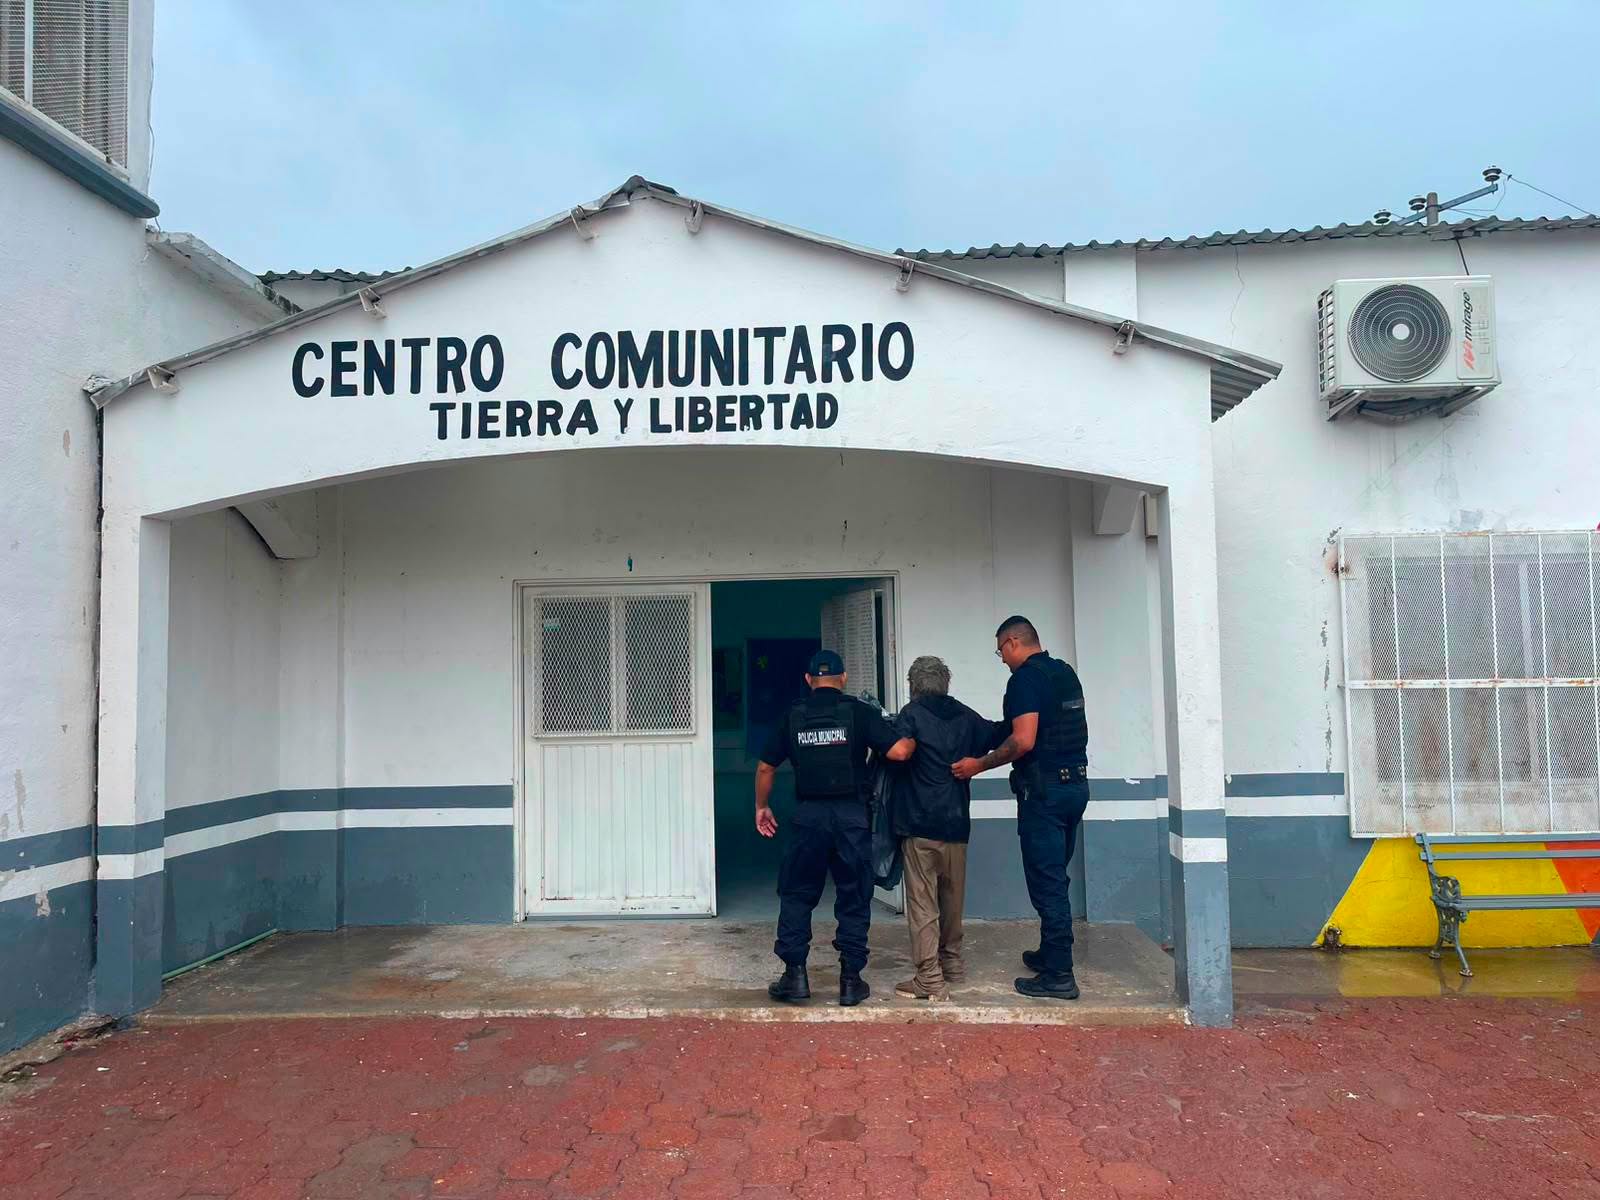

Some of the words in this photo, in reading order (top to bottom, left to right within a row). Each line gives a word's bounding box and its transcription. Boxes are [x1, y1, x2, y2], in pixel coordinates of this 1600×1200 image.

[1462, 291, 1473, 341] mirage
[293, 335, 504, 397] CENTRO
[551, 322, 914, 389] COMUNITARIO
[430, 400, 598, 440] TIERRA
[613, 398, 634, 434] Y
[650, 393, 838, 433] LIBERTAD
[797, 731, 817, 744] POLICIA
[818, 729, 847, 742] MUNICIPAL
